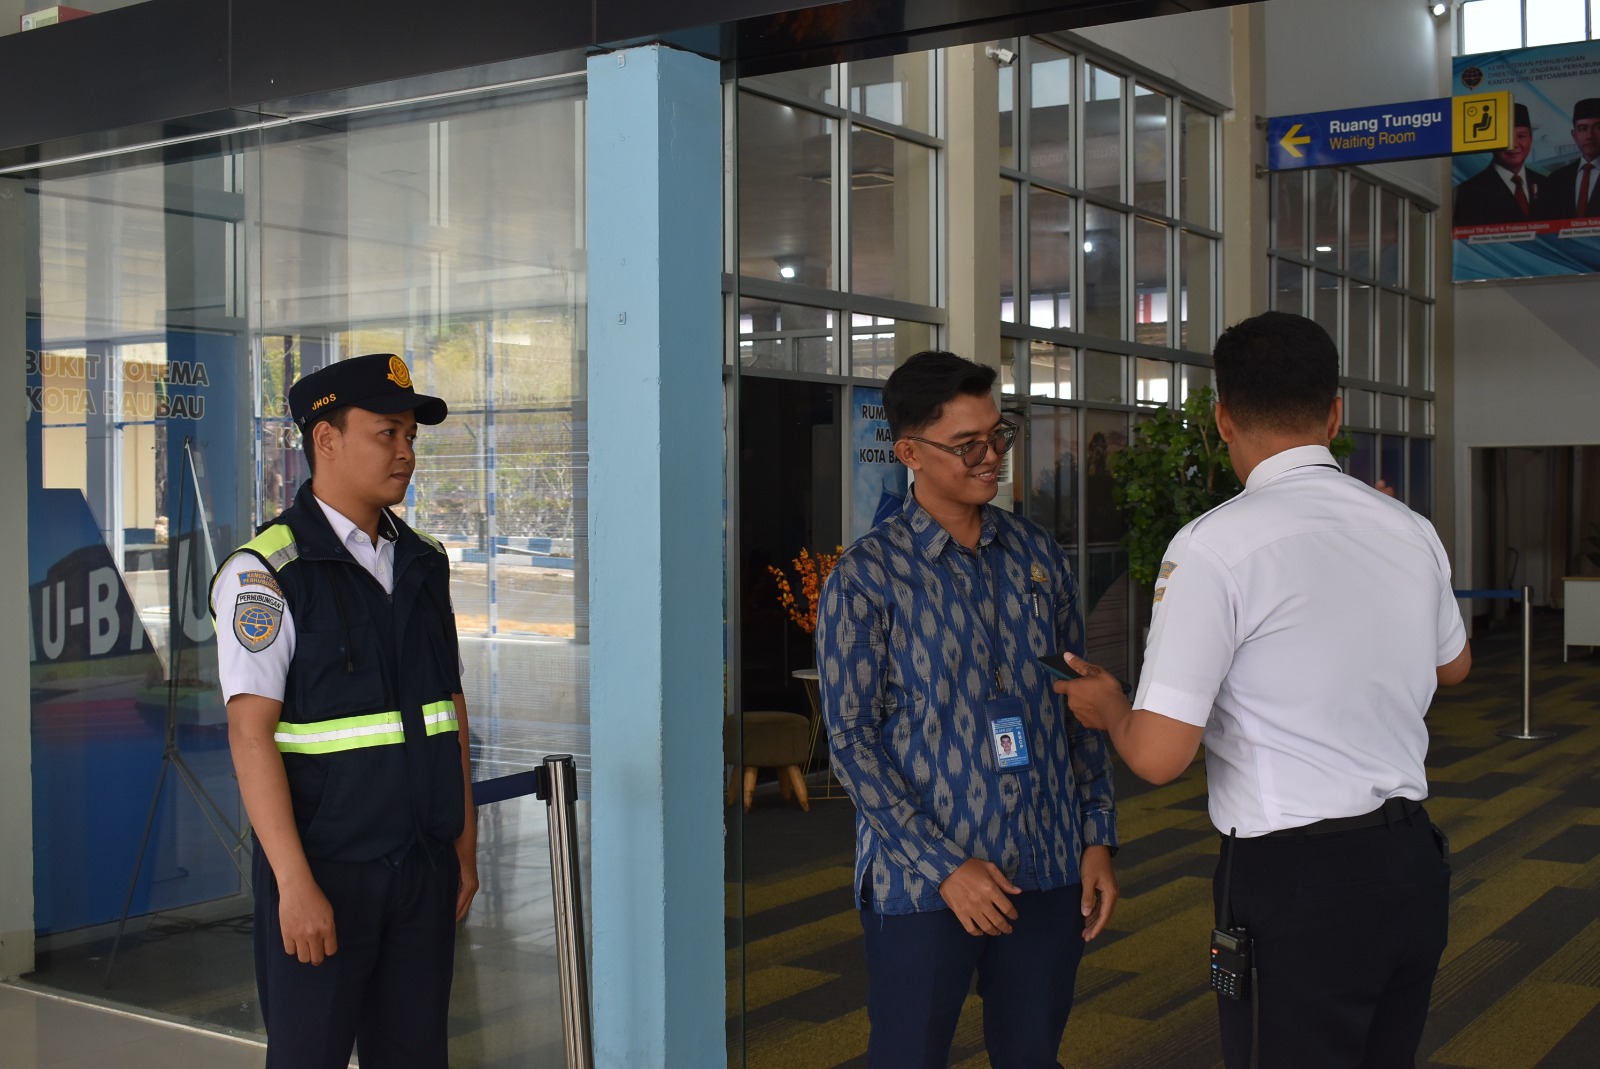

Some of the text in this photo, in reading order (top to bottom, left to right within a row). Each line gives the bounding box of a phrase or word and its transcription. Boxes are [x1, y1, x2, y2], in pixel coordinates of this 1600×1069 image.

[1529, 65, 1561, 74] JENDERAL
[1563, 62, 1600, 72] PERHUBUN
[1536, 55, 1585, 66] PERHUBUNGAN
[1488, 77, 1515, 85] KANTOR
[1329, 112, 1442, 133] Ruang Tunggu
[1329, 131, 1416, 150] Waiting Room
[26, 350, 210, 387] BUKIT KOLEMA
[26, 386, 205, 420] KOTA BAUBAU
[311, 393, 337, 411] JHOS
[862, 404, 887, 420] RUM
[875, 427, 895, 442] MA
[859, 448, 886, 463] KOTA
[240, 594, 282, 609] PERHUBUNGAN
